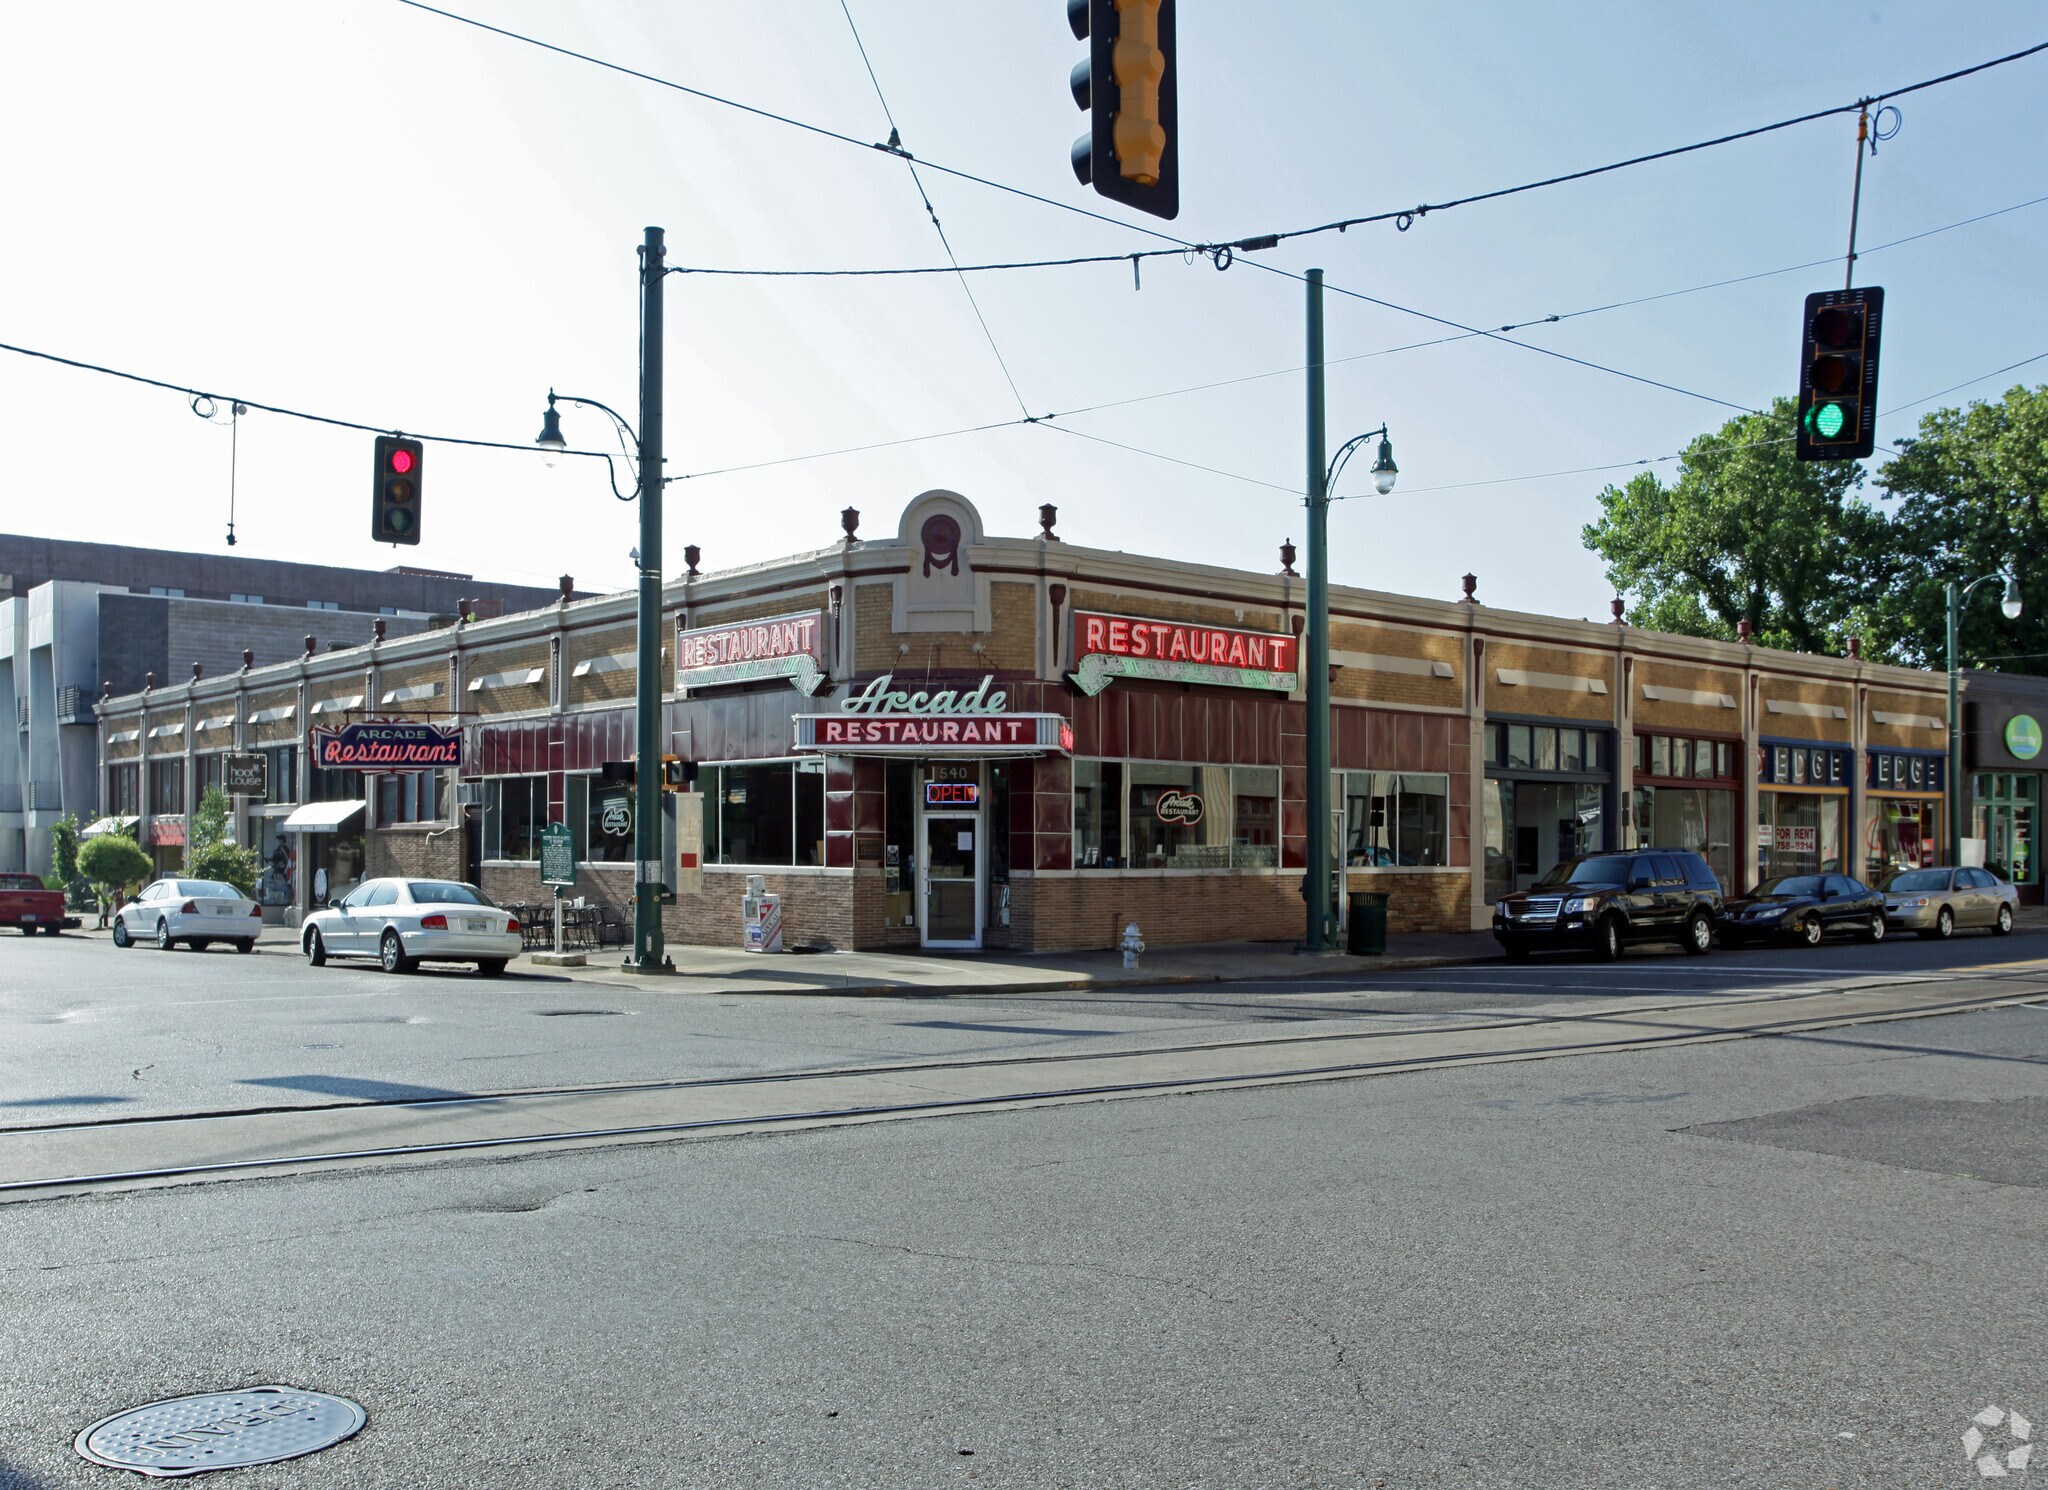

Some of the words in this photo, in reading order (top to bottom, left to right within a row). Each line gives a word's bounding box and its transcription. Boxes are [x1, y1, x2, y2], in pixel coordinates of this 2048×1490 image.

[682, 619, 816, 667] RESTAURANT
[1086, 618, 1288, 670] RESTAURANT
[841, 675, 1006, 715] Arcade
[357, 729, 428, 740] ARCADE
[827, 720, 1022, 743] RESTAURANT
[324, 741, 456, 764] Restaurant
[230, 765, 254, 777] hoot
[939, 767, 968, 779] 540
[929, 786, 975, 801] OPEN
[1161, 795, 1195, 809] Arcade
[1794, 828, 1814, 839] RENT
